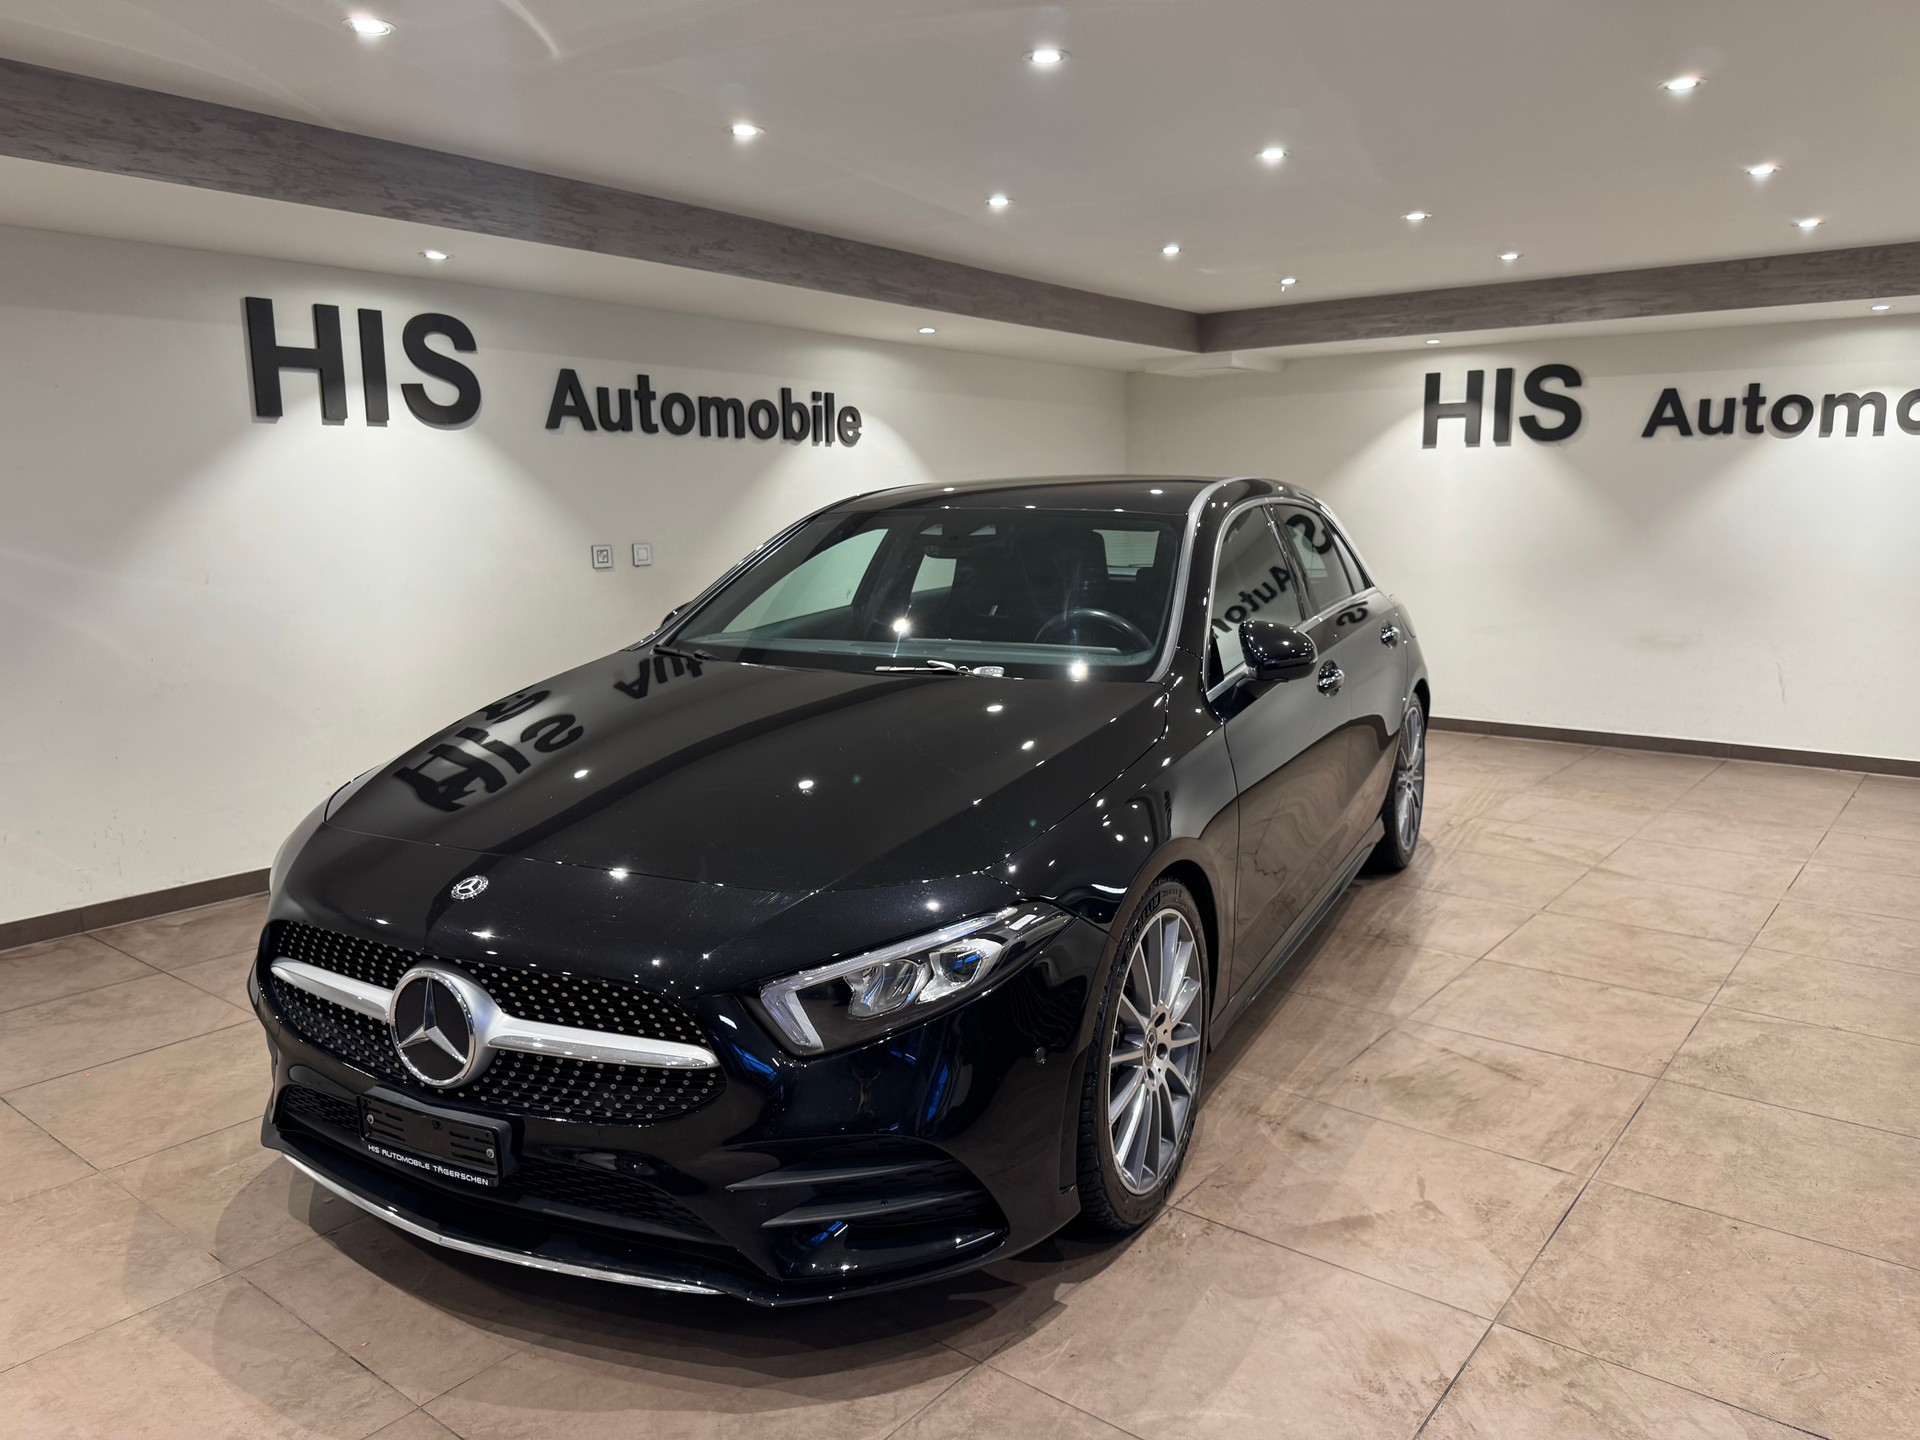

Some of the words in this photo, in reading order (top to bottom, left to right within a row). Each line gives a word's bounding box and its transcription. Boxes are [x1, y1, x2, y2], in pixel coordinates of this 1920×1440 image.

[245, 296, 481, 426] HIS
[545, 368, 862, 446] Automobile
[1423, 364, 1582, 446] HIS
[368, 1144, 380, 1154] HIS
[381, 1149, 430, 1170] AUTOMOBILE
[432, 1165, 489, 1186] TÄGERSCHEN
